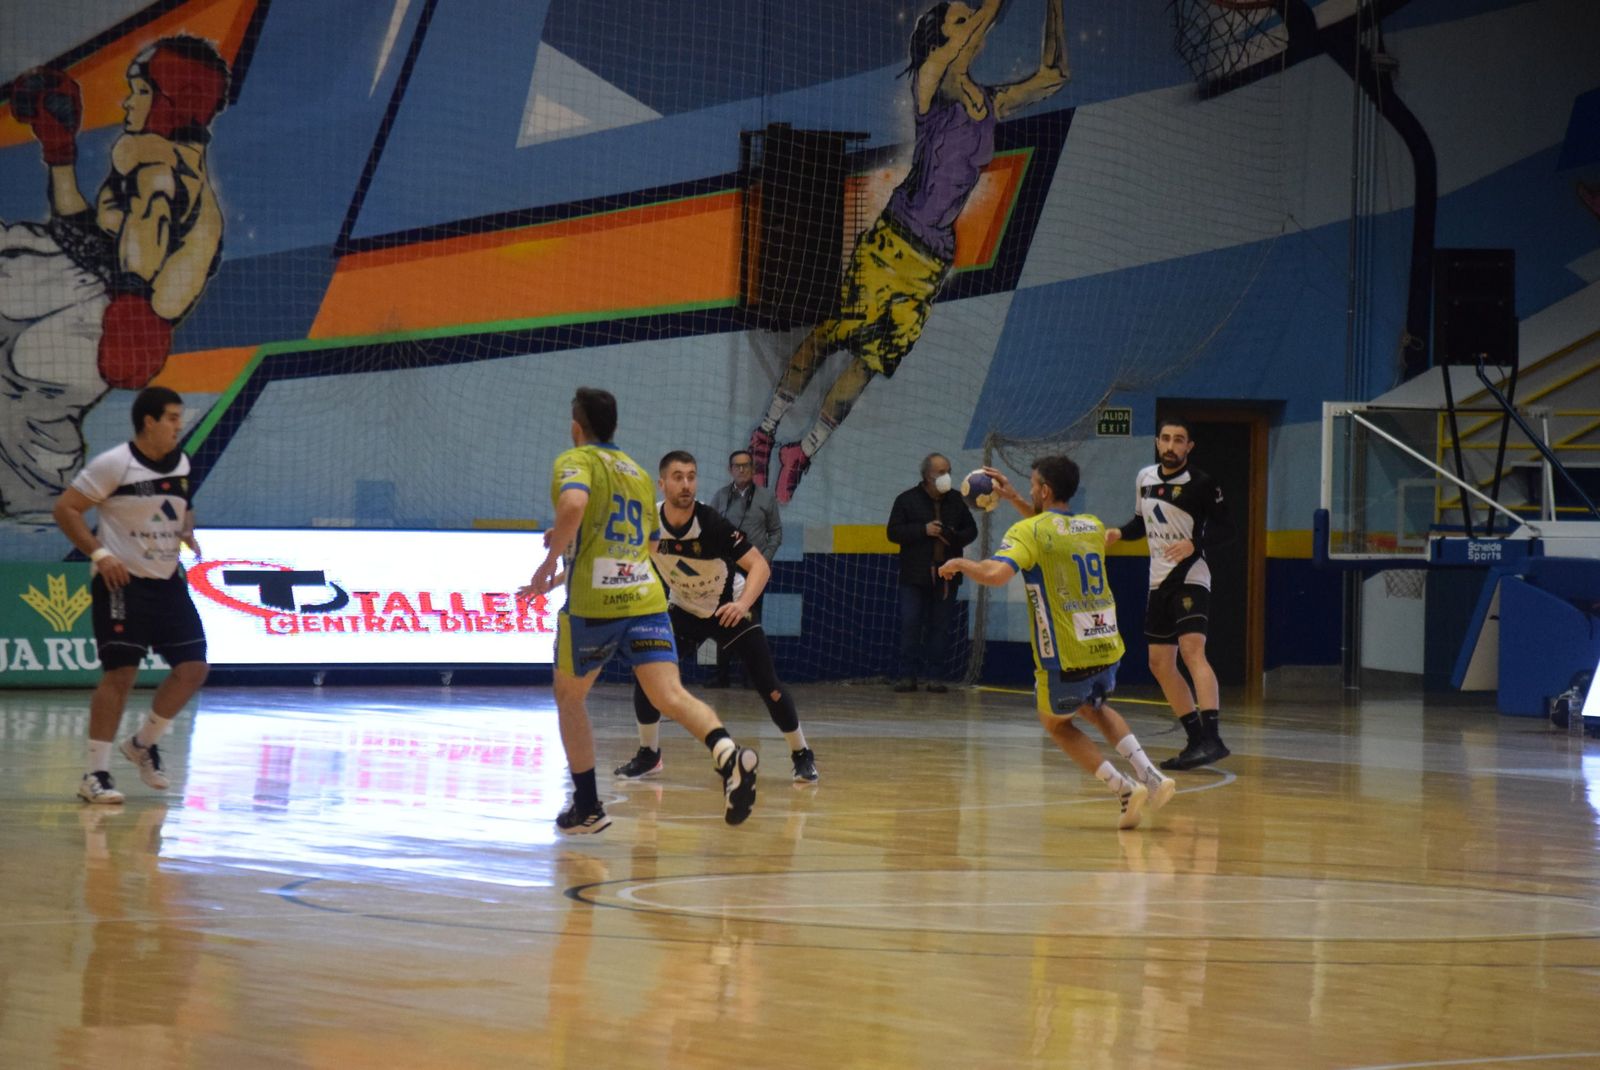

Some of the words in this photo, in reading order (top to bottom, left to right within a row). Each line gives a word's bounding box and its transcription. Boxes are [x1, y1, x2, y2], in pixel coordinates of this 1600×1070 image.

[1101, 423, 1127, 433] EXIT
[604, 494, 644, 546] 29
[1467, 551, 1502, 562] Sports
[1071, 553, 1104, 596] 19
[352, 591, 550, 615] TALLER
[265, 615, 429, 635] CENTRAL
[439, 613, 554, 633] DIESEL
